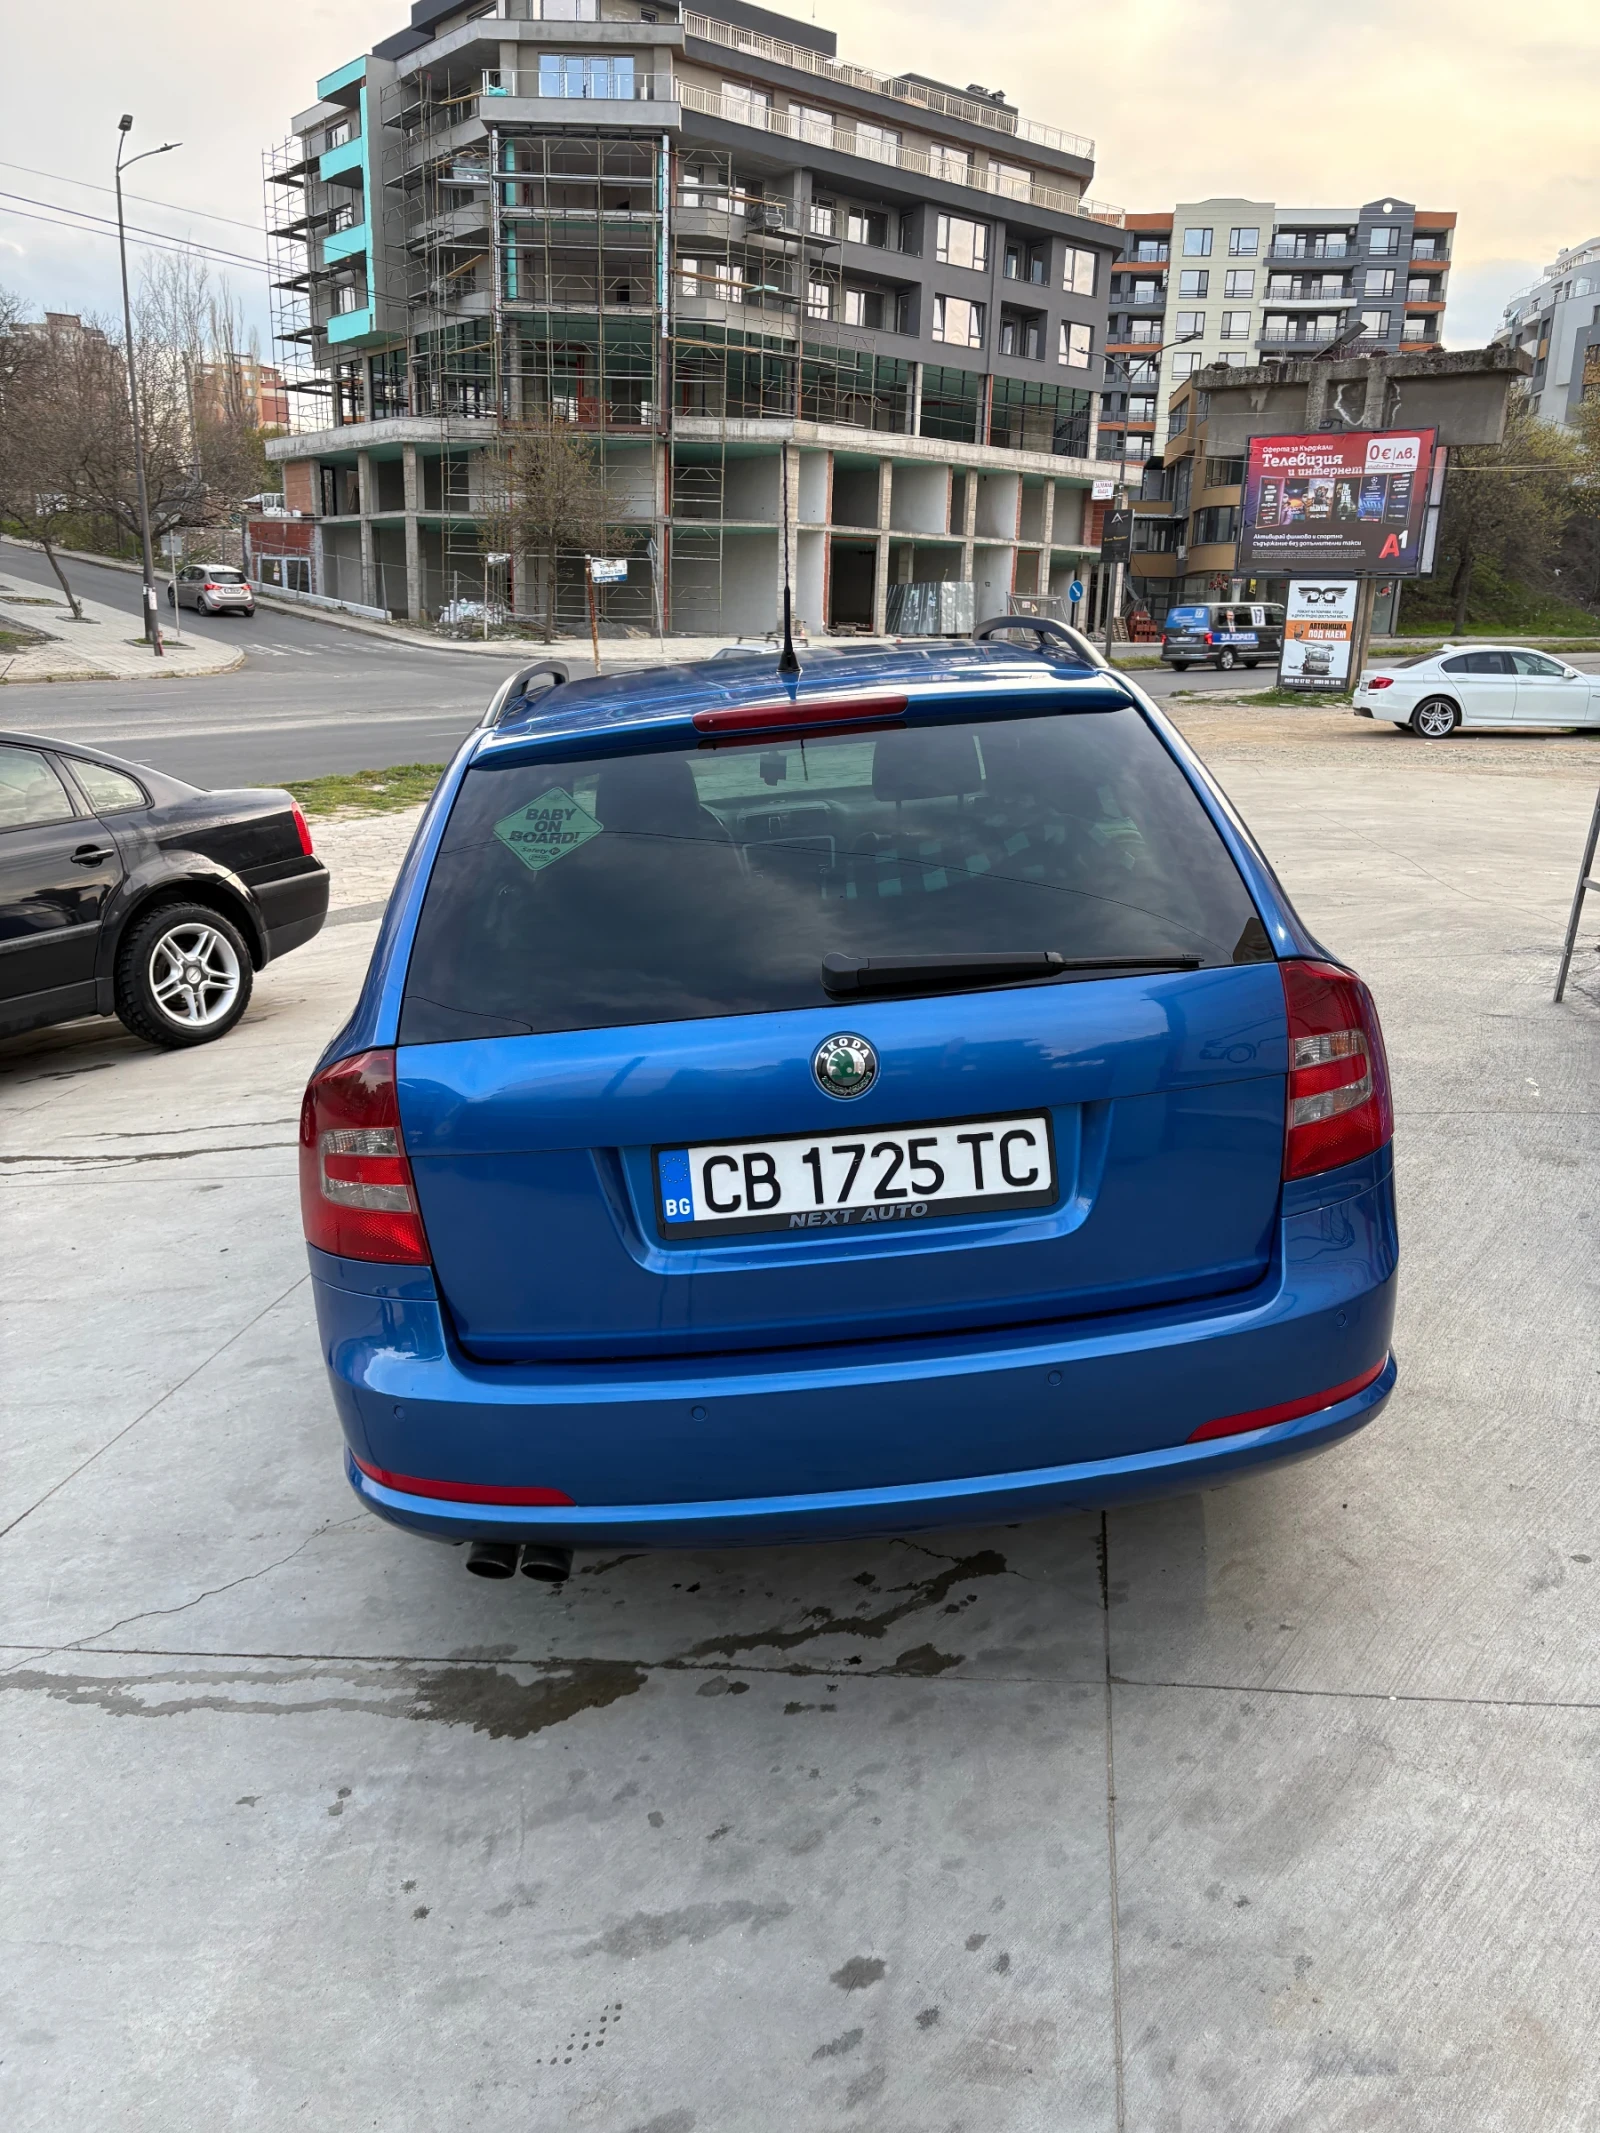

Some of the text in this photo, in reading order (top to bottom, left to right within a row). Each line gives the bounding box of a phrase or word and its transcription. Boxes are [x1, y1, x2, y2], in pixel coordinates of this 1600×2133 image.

[1262, 446, 1290, 454] Оферта
[1299, 444, 1333, 453] Кърджали
[1262, 453, 1343, 467] Телевизия
[1298, 467, 1363, 478] интернет
[1286, 533, 1312, 541] филмово
[1378, 530, 1409, 559] A1
[1308, 630, 1347, 639] ПОД НАЕМ
[525, 809, 577, 820] BABY
[534, 820, 562, 832] ON
[509, 831, 580, 844] BOARD!
[521, 846, 549, 855] Safety
[702, 1129, 1040, 1214] CB 1725 TC
[665, 1200, 691, 1217] BG
[788, 1202, 929, 1229] NEXT AUTO
